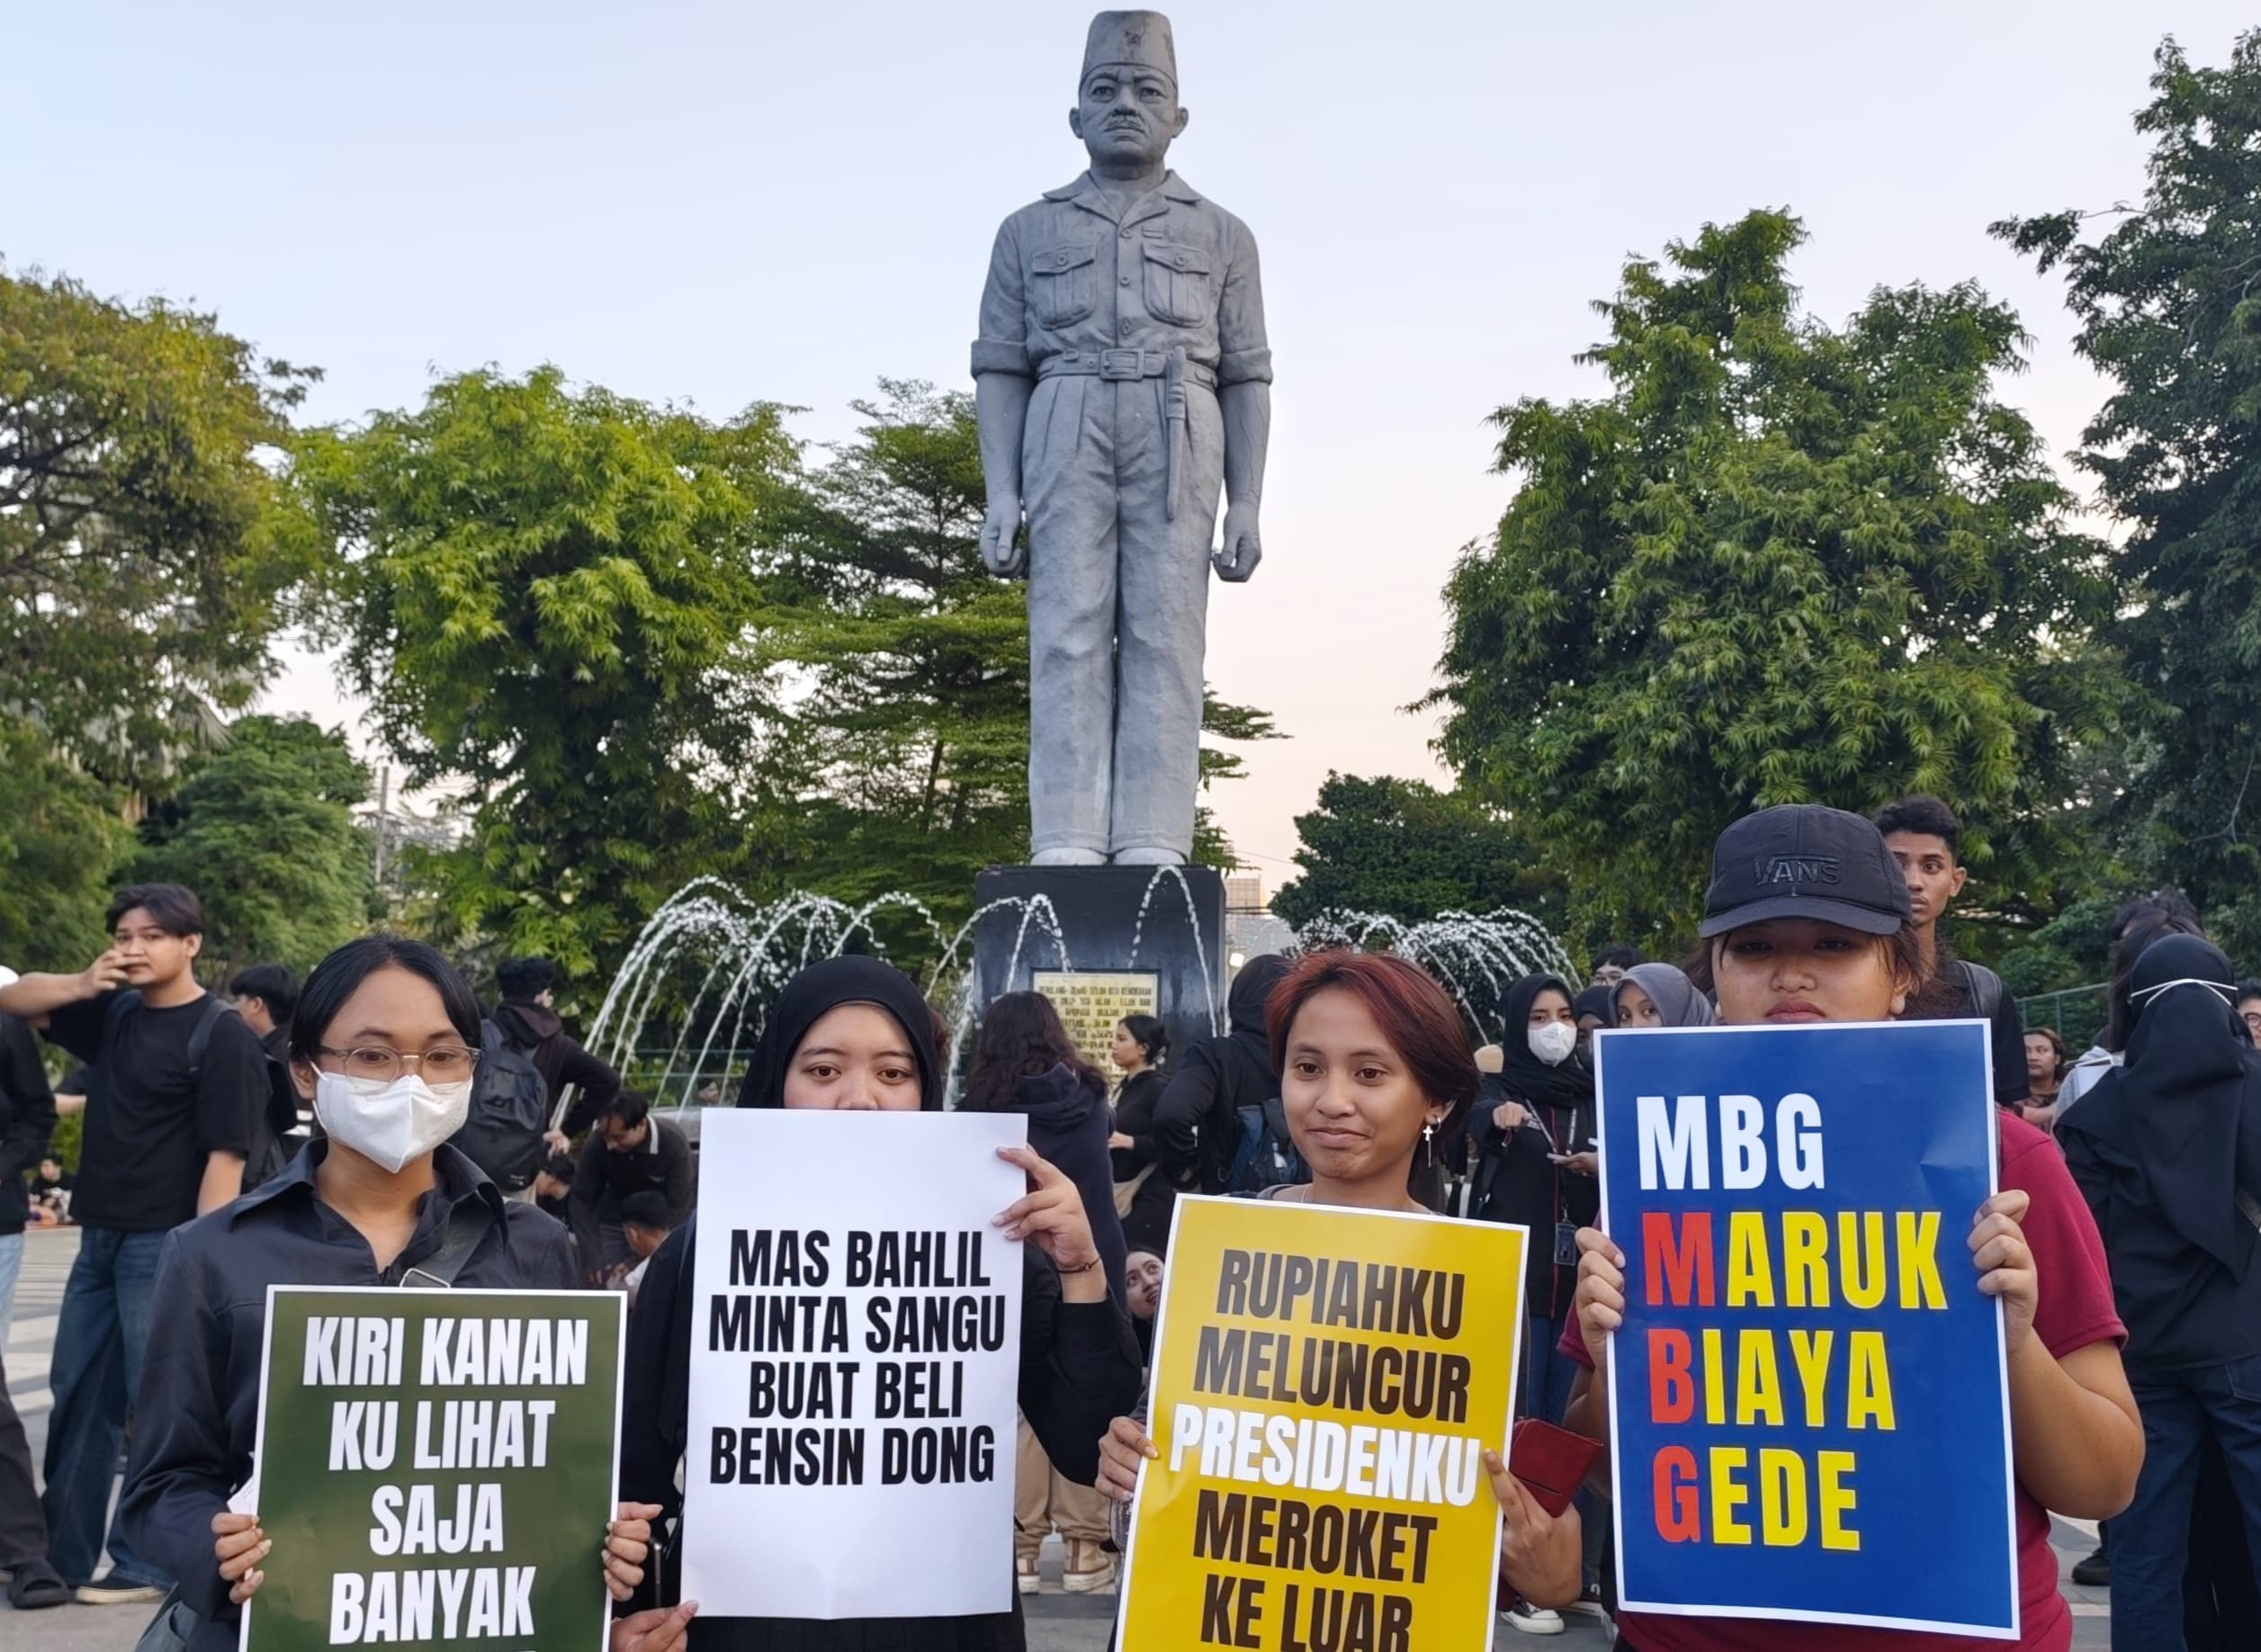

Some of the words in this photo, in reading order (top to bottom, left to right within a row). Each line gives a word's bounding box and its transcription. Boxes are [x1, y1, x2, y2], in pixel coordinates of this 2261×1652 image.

[1754, 856, 1843, 886] VANS
[1637, 1092, 1825, 1190] MBG
[729, 1229, 830, 1288] MAS
[846, 1230, 991, 1288] BAHLIL
[1216, 1249, 1465, 1341] RUPIAHKU
[1642, 1211, 1948, 1310] MARUK
[303, 1316, 405, 1386] KIRI
[420, 1317, 588, 1386] KANAN
[709, 1294, 849, 1353] MINTA
[866, 1295, 1006, 1353] SANGU
[749, 1360, 860, 1420] BUAT
[875, 1360, 964, 1419] BELI
[1194, 1325, 1471, 1424] MELUNCUR
[1647, 1328, 1896, 1431] BIAYA
[328, 1401, 399, 1471] KU
[413, 1400, 556, 1469] LIHAT
[710, 1426, 865, 1486] BENSIN
[881, 1424, 995, 1486] DONG
[1170, 1403, 1480, 1505] PRESIDENKU
[369, 1483, 504, 1556] SAJA
[1193, 1488, 1439, 1585] MEROKET
[1653, 1445, 1861, 1551] GEDE
[328, 1566, 537, 1645] BANYAK
[1200, 1573, 1266, 1649] KE
[1279, 1583, 1413, 1652] LUAR
